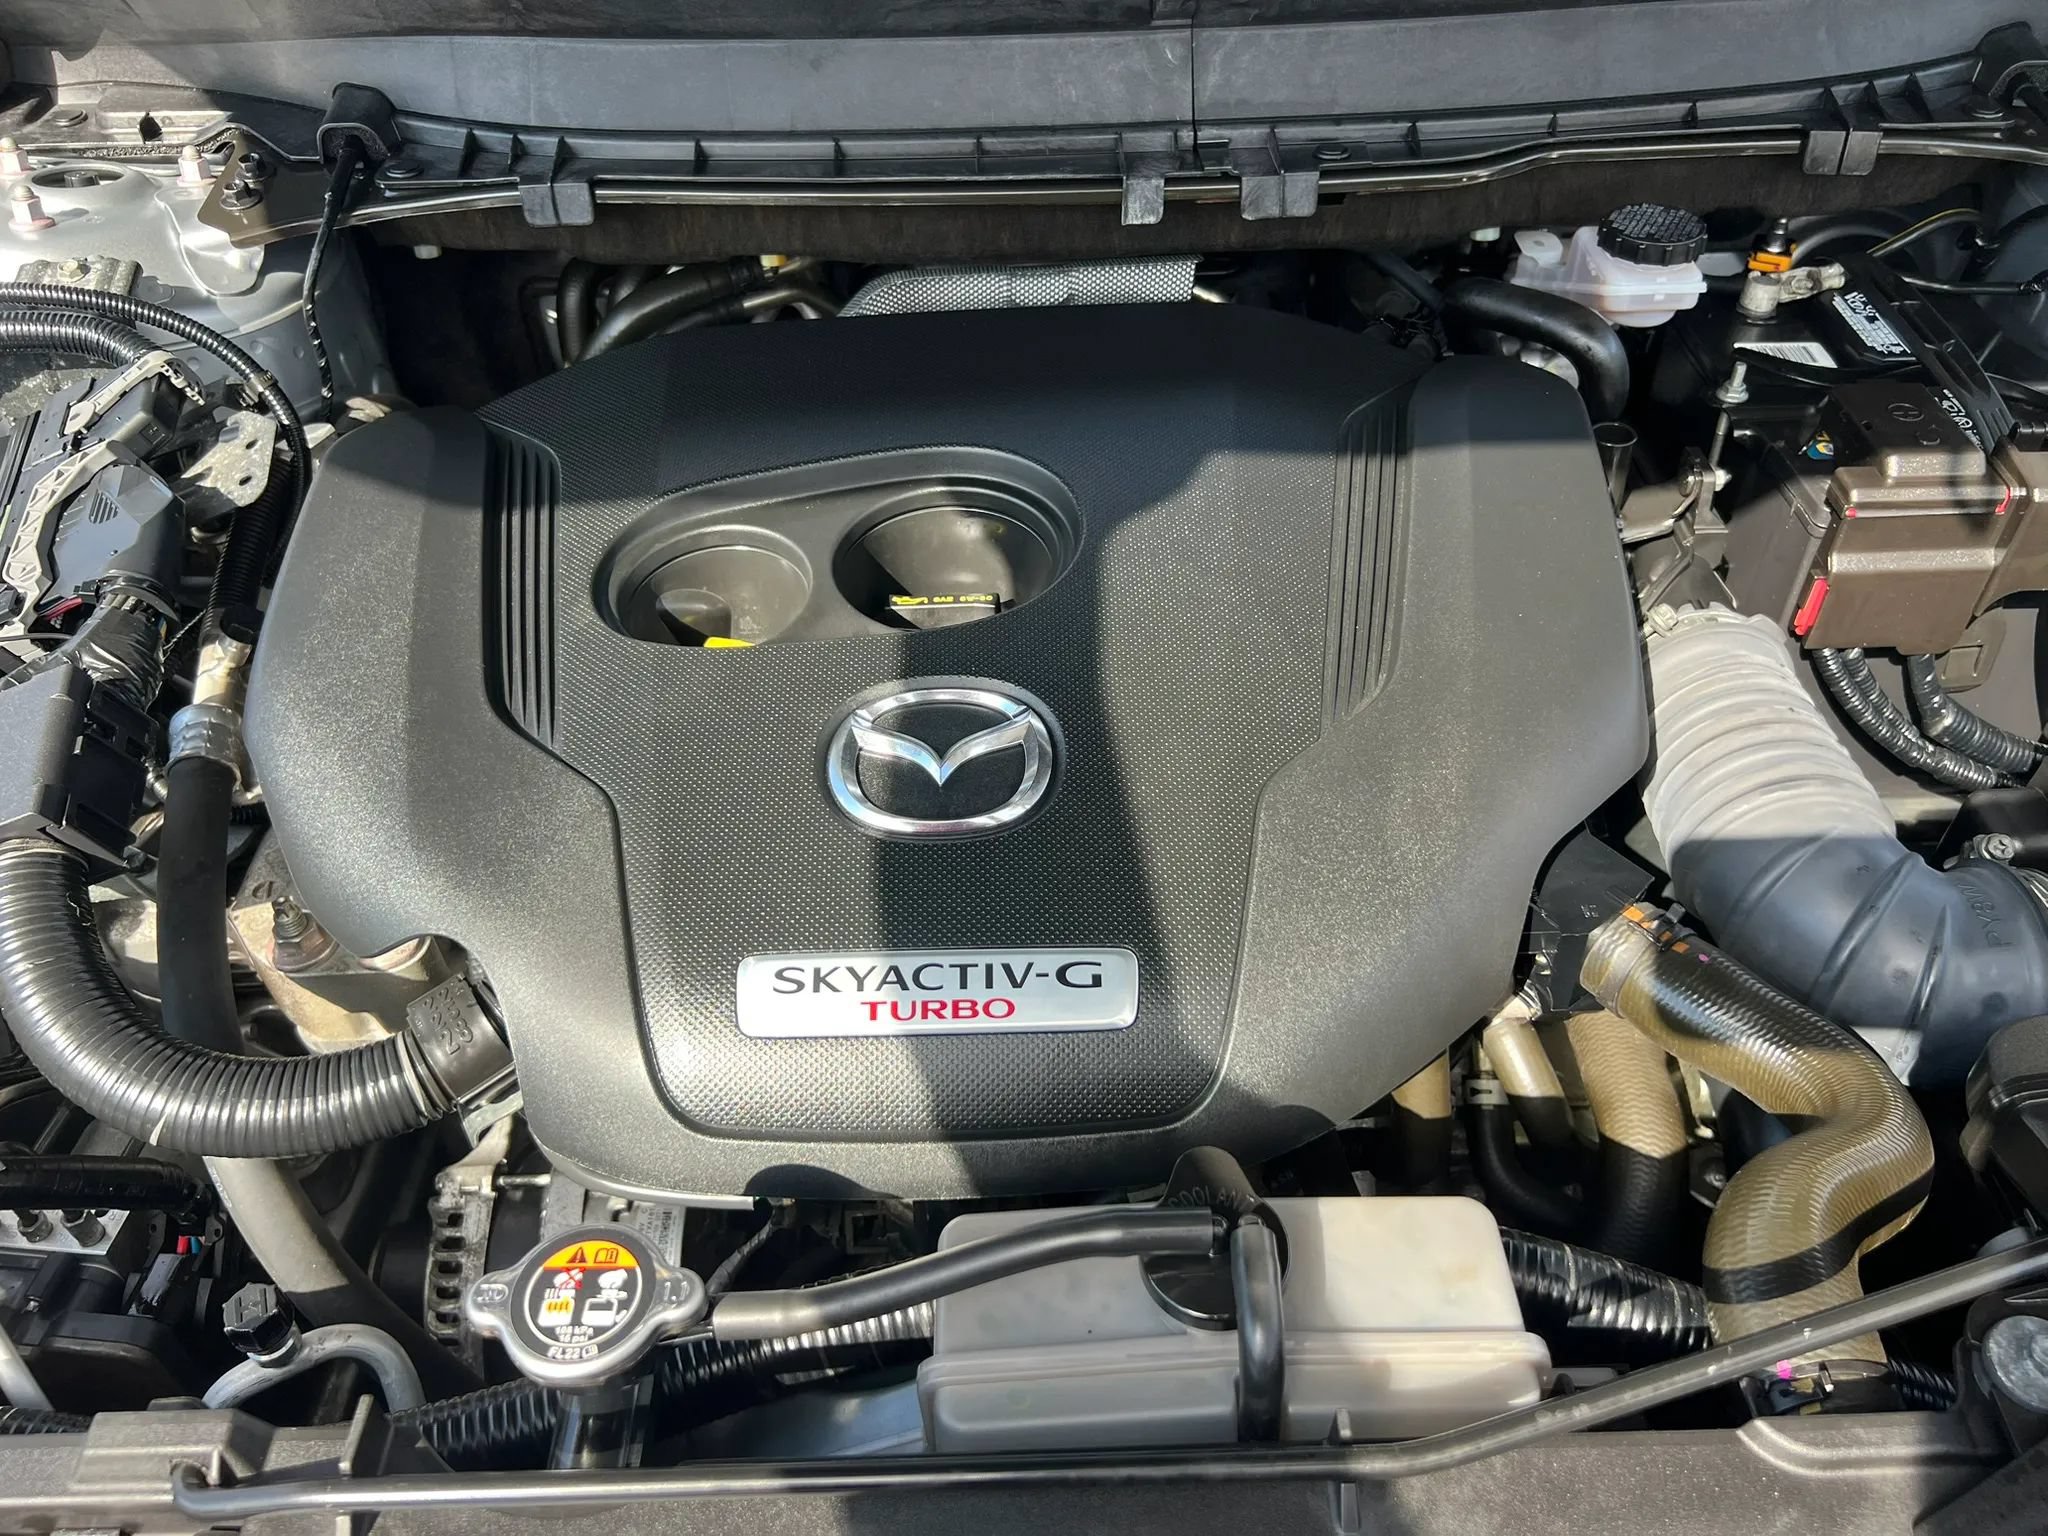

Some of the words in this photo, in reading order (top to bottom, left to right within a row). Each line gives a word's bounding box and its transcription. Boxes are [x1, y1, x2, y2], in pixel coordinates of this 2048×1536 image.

[772, 961, 1103, 994] SKYACTIV-G
[860, 998, 1015, 1021] TURBO
[547, 1346, 580, 1360] FL22
